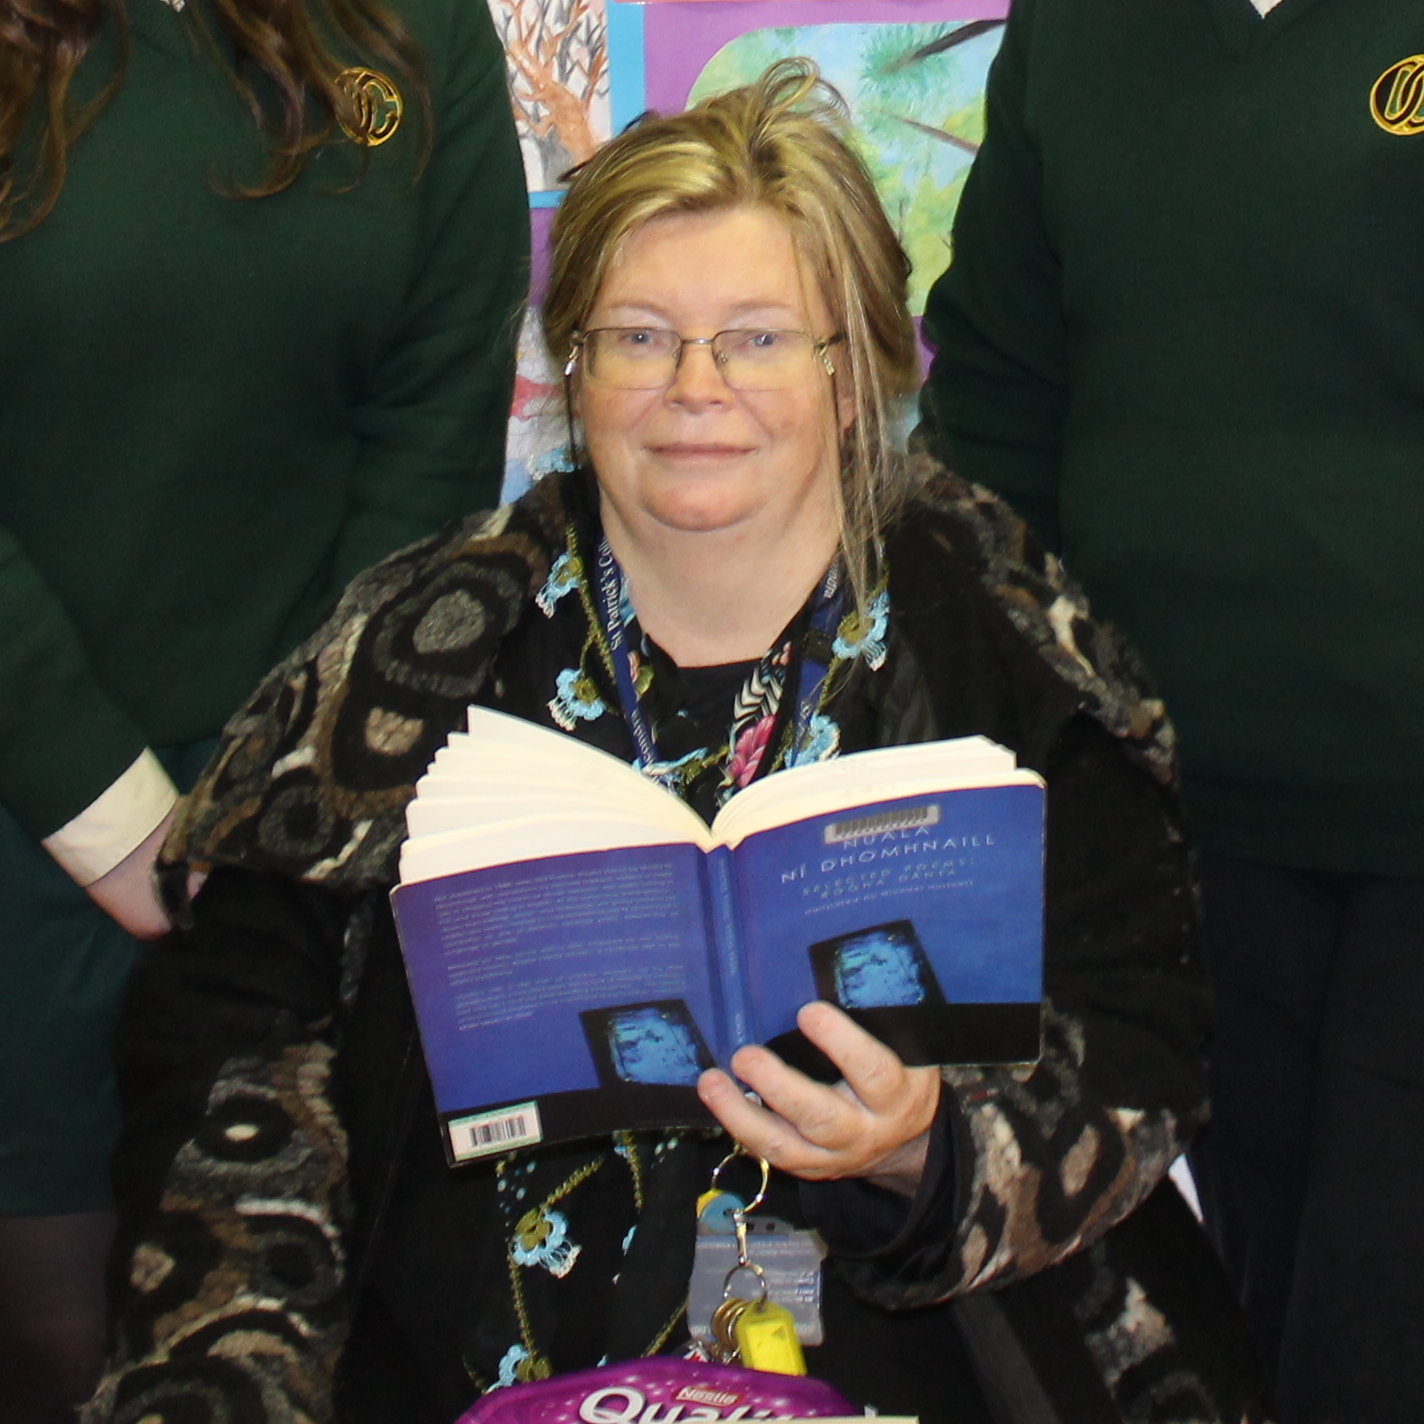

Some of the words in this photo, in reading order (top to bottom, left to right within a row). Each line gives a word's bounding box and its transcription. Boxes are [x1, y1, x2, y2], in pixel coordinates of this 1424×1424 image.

[598, 567, 624, 632] Patrick's
[820, 833, 996, 873] DHOMHNAILL
[843, 825, 930, 851] NUALA
